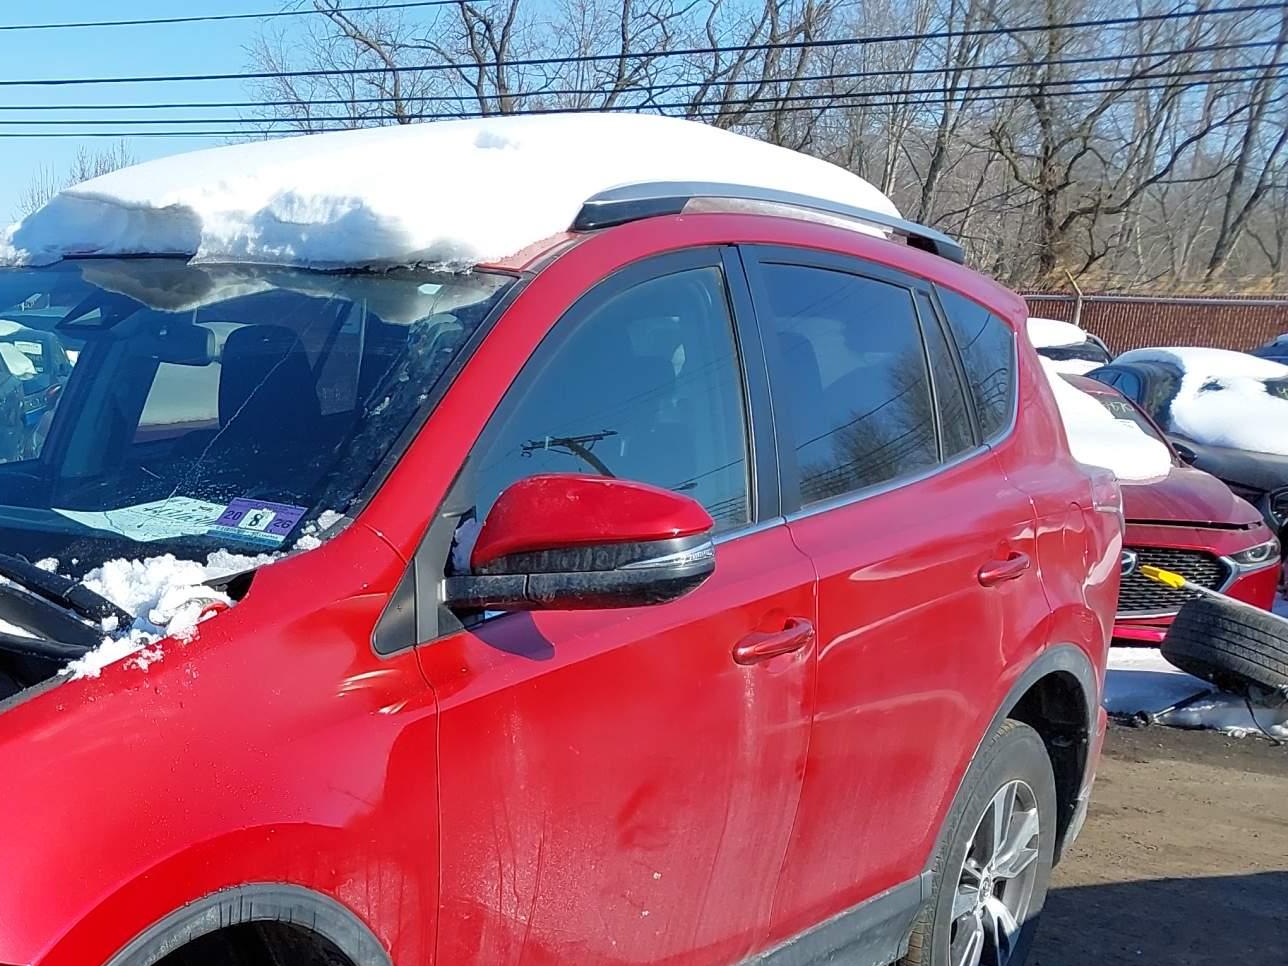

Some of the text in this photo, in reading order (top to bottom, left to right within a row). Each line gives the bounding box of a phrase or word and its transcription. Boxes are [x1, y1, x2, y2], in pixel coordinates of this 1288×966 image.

[223, 510, 294, 529] 20 8 26
